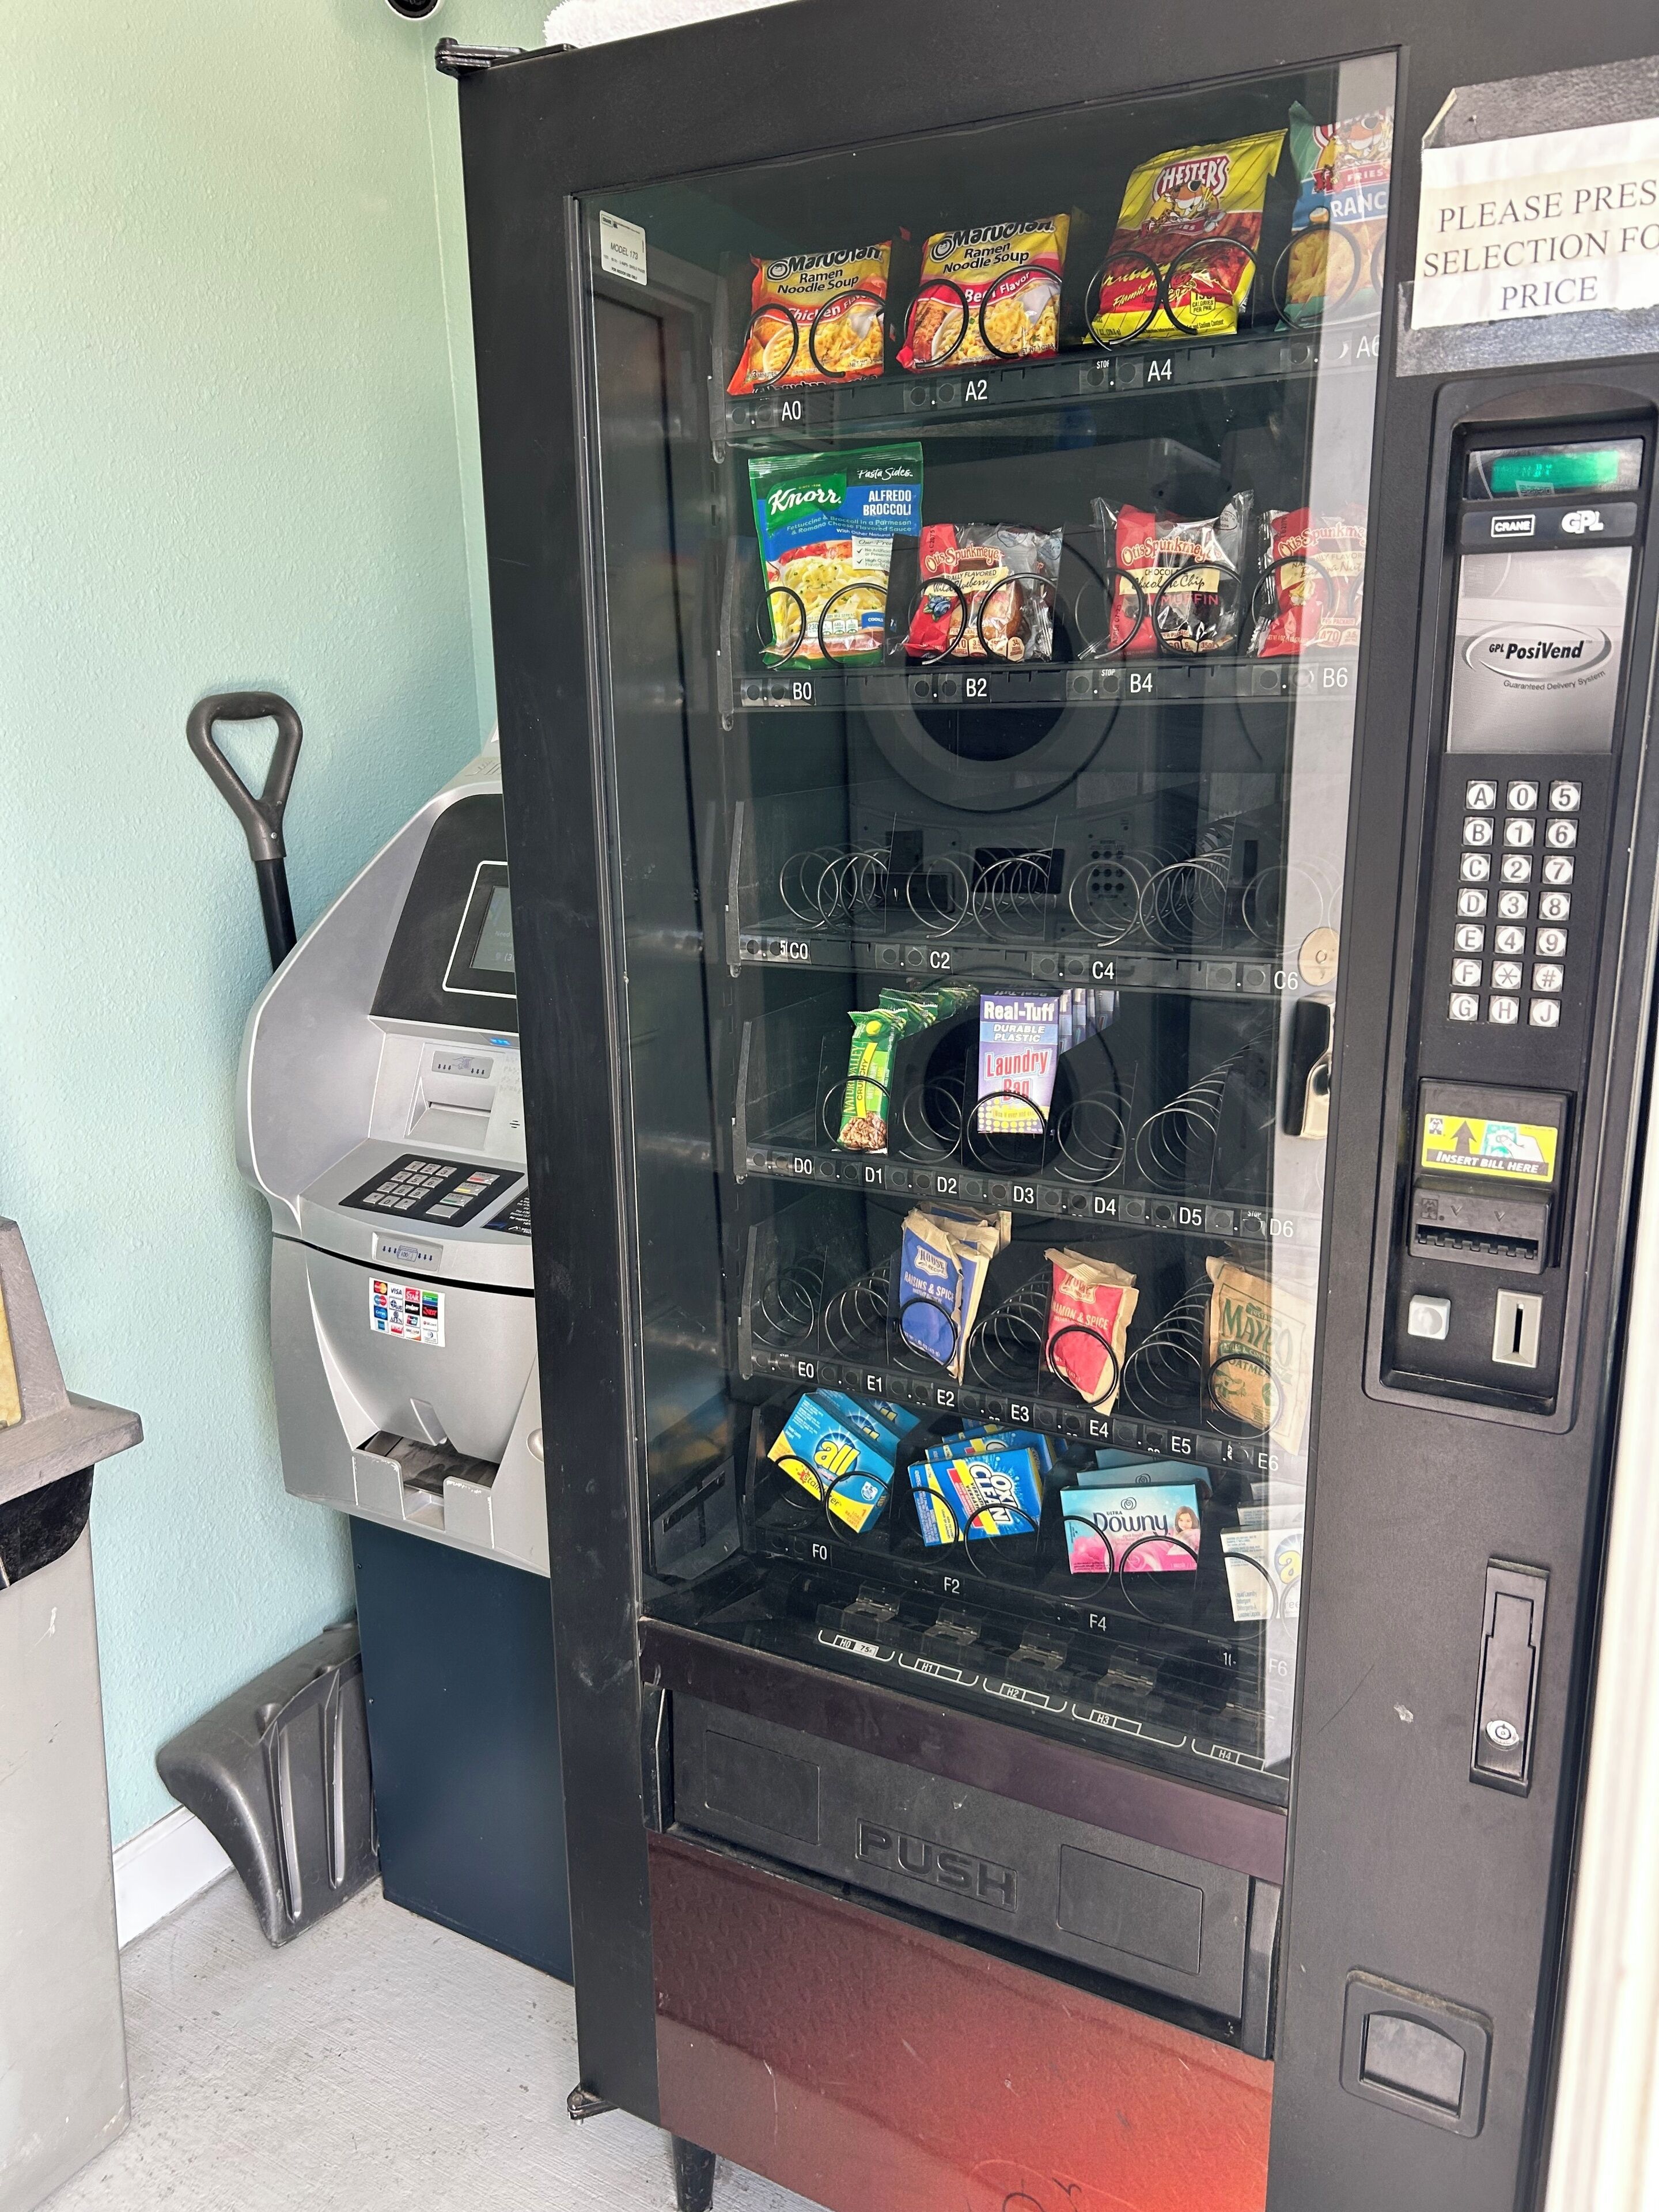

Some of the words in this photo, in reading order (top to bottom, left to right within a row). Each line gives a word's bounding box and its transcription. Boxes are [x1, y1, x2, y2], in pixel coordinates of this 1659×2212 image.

[1154, 158, 1228, 202] CHESTER'S
[1347, 169, 1384, 183] FRIES
[1438, 191, 1563, 233] PLEASE
[1574, 178, 1657, 216] PRES
[611, 243, 629, 257] MODEL
[630, 250, 638, 260] 173
[964, 243, 1010, 259] Ramen
[1423, 229, 1609, 279] SELECTION
[1620, 224, 1659, 254] FO
[943, 259, 990, 274] Noodle
[993, 251, 1029, 264] Soup
[777, 282, 825, 294] Noodle
[827, 275, 859, 290] Soup
[799, 268, 843, 283] Ramen
[999, 272, 1030, 295] Flavor
[1501, 275, 1599, 312] PRICE
[1147, 358, 1172, 382] A4
[965, 379, 988, 402] A2
[781, 400, 801, 421] A0
[857, 468, 882, 479] Pasta
[768, 487, 840, 515] Knorr
[868, 490, 911, 503] ALFREDO
[863, 503, 912, 516] BROCCOLI
[787, 517, 821, 531] Fettuccine
[830, 516, 859, 524] Broccoli
[798, 522, 826, 533] Romano
[828, 521, 854, 529] Cheese
[1494, 521, 1531, 533] CRANE
[1561, 509, 1604, 534] GPL
[1121, 543, 1146, 566] Otis
[1278, 535, 1302, 558] Otis
[925, 551, 945, 573] Otis
[964, 570, 997, 578] FLAVORED
[1180, 573, 1205, 591] Chip
[1161, 594, 1219, 607] MUFFIN
[1488, 643, 1504, 654] GPL
[1505, 639, 1584, 660] PosiVend
[1101, 669, 1115, 677] STOP
[1323, 666, 1348, 688] B6
[1503, 679, 1545, 691] Guaranteed
[1547, 678, 1576, 691] Delivery
[1577, 670, 1606, 687] System
[792, 681, 812, 700] B0
[965, 677, 987, 697] B2
[1130, 673, 1153, 693] B4
[1473, 787, 1487, 806] A
[1516, 787, 1529, 806] 0
[1559, 787, 1571, 806] 5
[1472, 823, 1485, 842] B
[1514, 825, 1524, 843] 1
[1555, 825, 1568, 843] 6
[1469, 859, 1482, 878] C
[1510, 861, 1523, 878] 2
[1553, 862, 1566, 880] 7
[1467, 895, 1480, 913] D
[1508, 896, 1519, 914] 3
[1549, 898, 1561, 916] 8
[1465, 930, 1476, 948] E
[1504, 932, 1516, 949] 4
[1546, 933, 1558, 952] 9
[790, 942, 808, 960] C0
[929, 950, 950, 969] C2
[1092, 960, 1115, 980] C4
[1462, 965, 1474, 982] F
[1273, 970, 1298, 990] C6
[984, 1000, 1055, 1021] Real-Tuff
[1458, 999, 1471, 1017] G
[1498, 1002, 1510, 1019] H
[1540, 1005, 1552, 1022] J
[993, 1024, 1046, 1034] DURABLE
[994, 1033, 1041, 1043] PLASTIC
[848, 1044, 866, 1077] VALLEY
[987, 1048, 1048, 1078] Laundry
[794, 1157, 813, 1175] D0
[1436, 1151, 1479, 1166] INSERT
[1480, 1158, 1505, 1169] BILL
[1507, 1161, 1539, 1173] HERE
[865, 1166, 883, 1184] D1
[937, 1175, 958, 1194] D2
[1013, 1185, 1035, 1204] D3
[1094, 1196, 1116, 1215] D4
[1179, 1206, 1202, 1226] D5
[1269, 1218, 1294, 1237] D6
[920, 1249, 945, 1270] HOUSE
[391, 1287, 402, 1296] VISA
[406, 1292, 419, 1301] STAR
[904, 1271, 927, 1291] RAISINS
[928, 1283, 934, 1294] &
[935, 1286, 955, 1303] SPICE
[1076, 1312, 1084, 1323] &
[1086, 1314, 1109, 1330] SPICE
[1221, 1297, 1293, 1368] MAYPO
[798, 1361, 815, 1378] E0
[867, 1375, 882, 1392] E1
[937, 1389, 955, 1407] E2
[1011, 1403, 1029, 1422] E3
[1090, 1419, 1109, 1438] E4
[1171, 1437, 1192, 1455] E5
[813, 1440, 861, 1476] all
[1258, 1452, 1279, 1471] E6
[969, 1464, 1012, 1522] CLEAN
[990, 1474, 1018, 1510] OXI
[1093, 1512, 1166, 1536] Downy
[812, 1543, 828, 1560] F0
[944, 1577, 960, 1594] F2
[1089, 1613, 1107, 1632] F4
[839, 1639, 851, 1648] H0
[922, 1663, 933, 1673] H1
[1269, 1658, 1288, 1677] F6
[1007, 1687, 1019, 1698] H2
[1097, 1714, 1109, 1725] H3
[1218, 1750, 1231, 1760] H4
[859, 1822, 1016, 1906] PUSH
